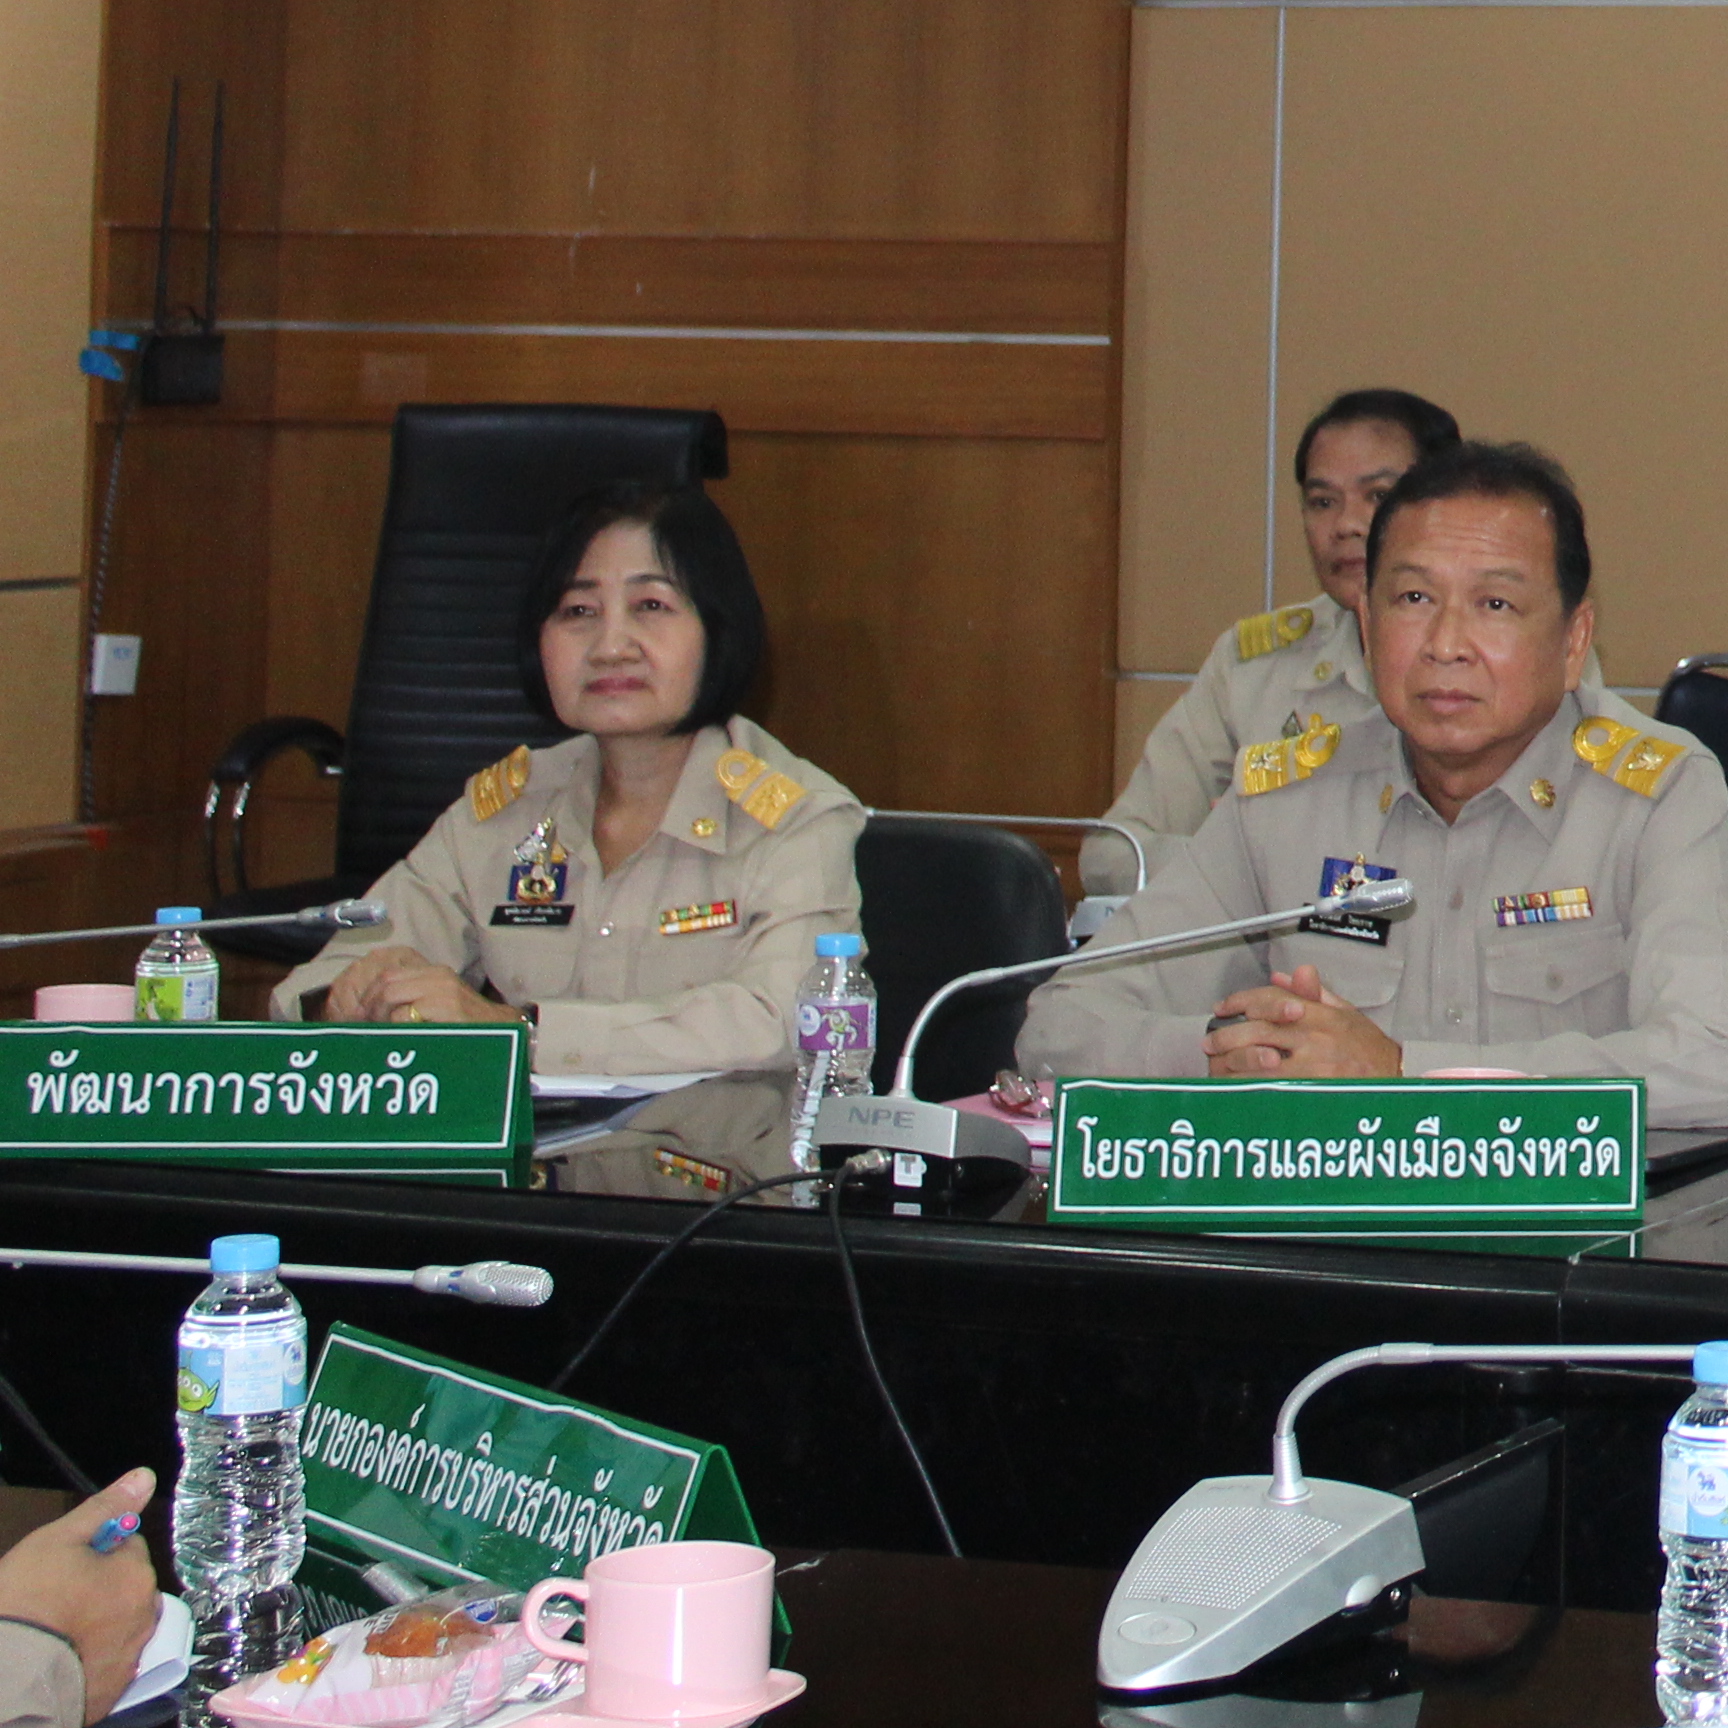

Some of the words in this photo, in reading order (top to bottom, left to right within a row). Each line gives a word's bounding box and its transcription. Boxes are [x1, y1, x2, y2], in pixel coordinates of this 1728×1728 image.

[27, 1048, 440, 1115] พัฒนาการจังหวัด
[848, 1106, 916, 1129] NPE
[1075, 1115, 1621, 1178] โยธาธิการและผังเมืองจังหวัด
